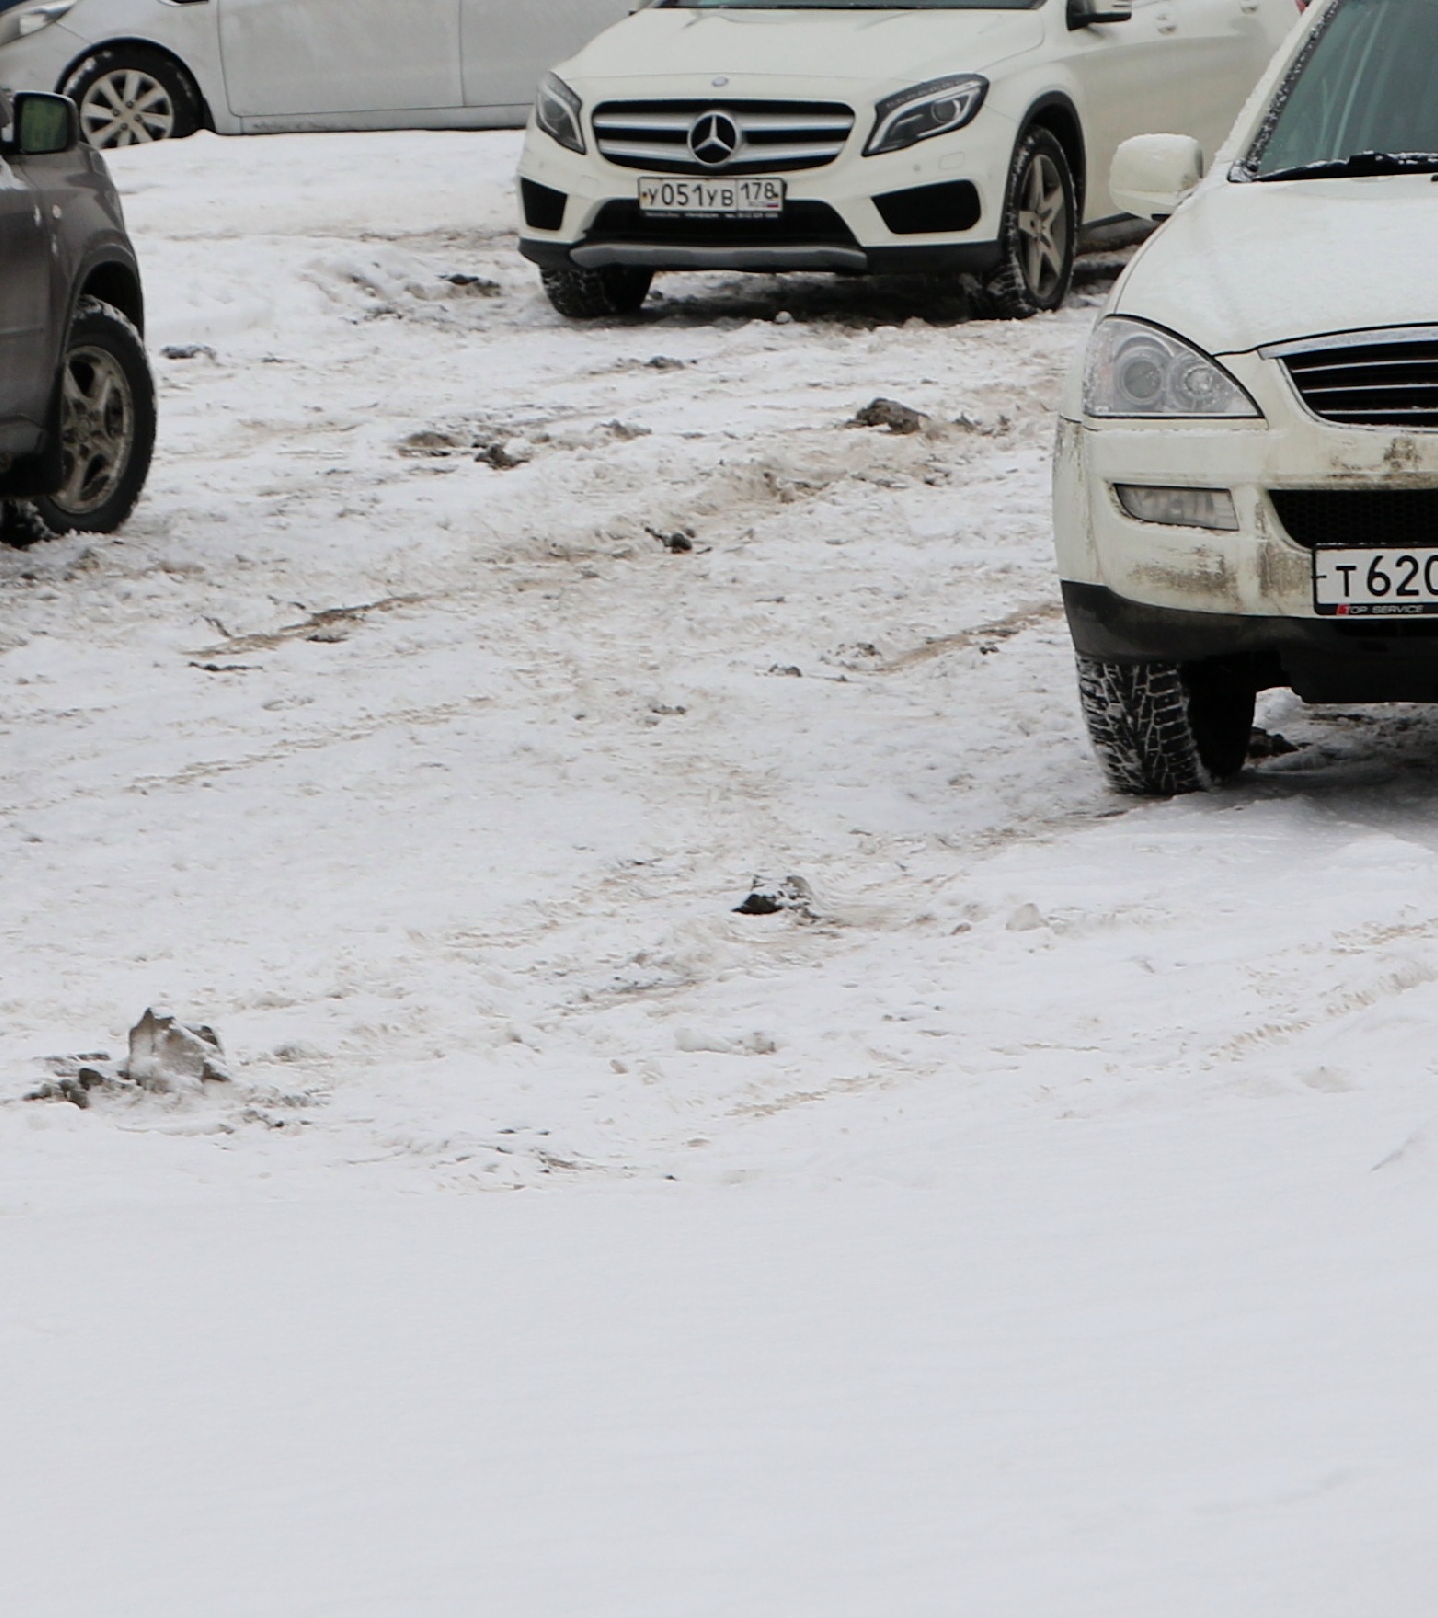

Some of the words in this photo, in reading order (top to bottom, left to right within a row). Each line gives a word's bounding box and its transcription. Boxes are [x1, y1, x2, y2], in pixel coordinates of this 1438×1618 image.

[647, 183, 734, 207] У051УВ
[740, 181, 775, 200] 178
[1371, 604, 1425, 614] SERVICE
